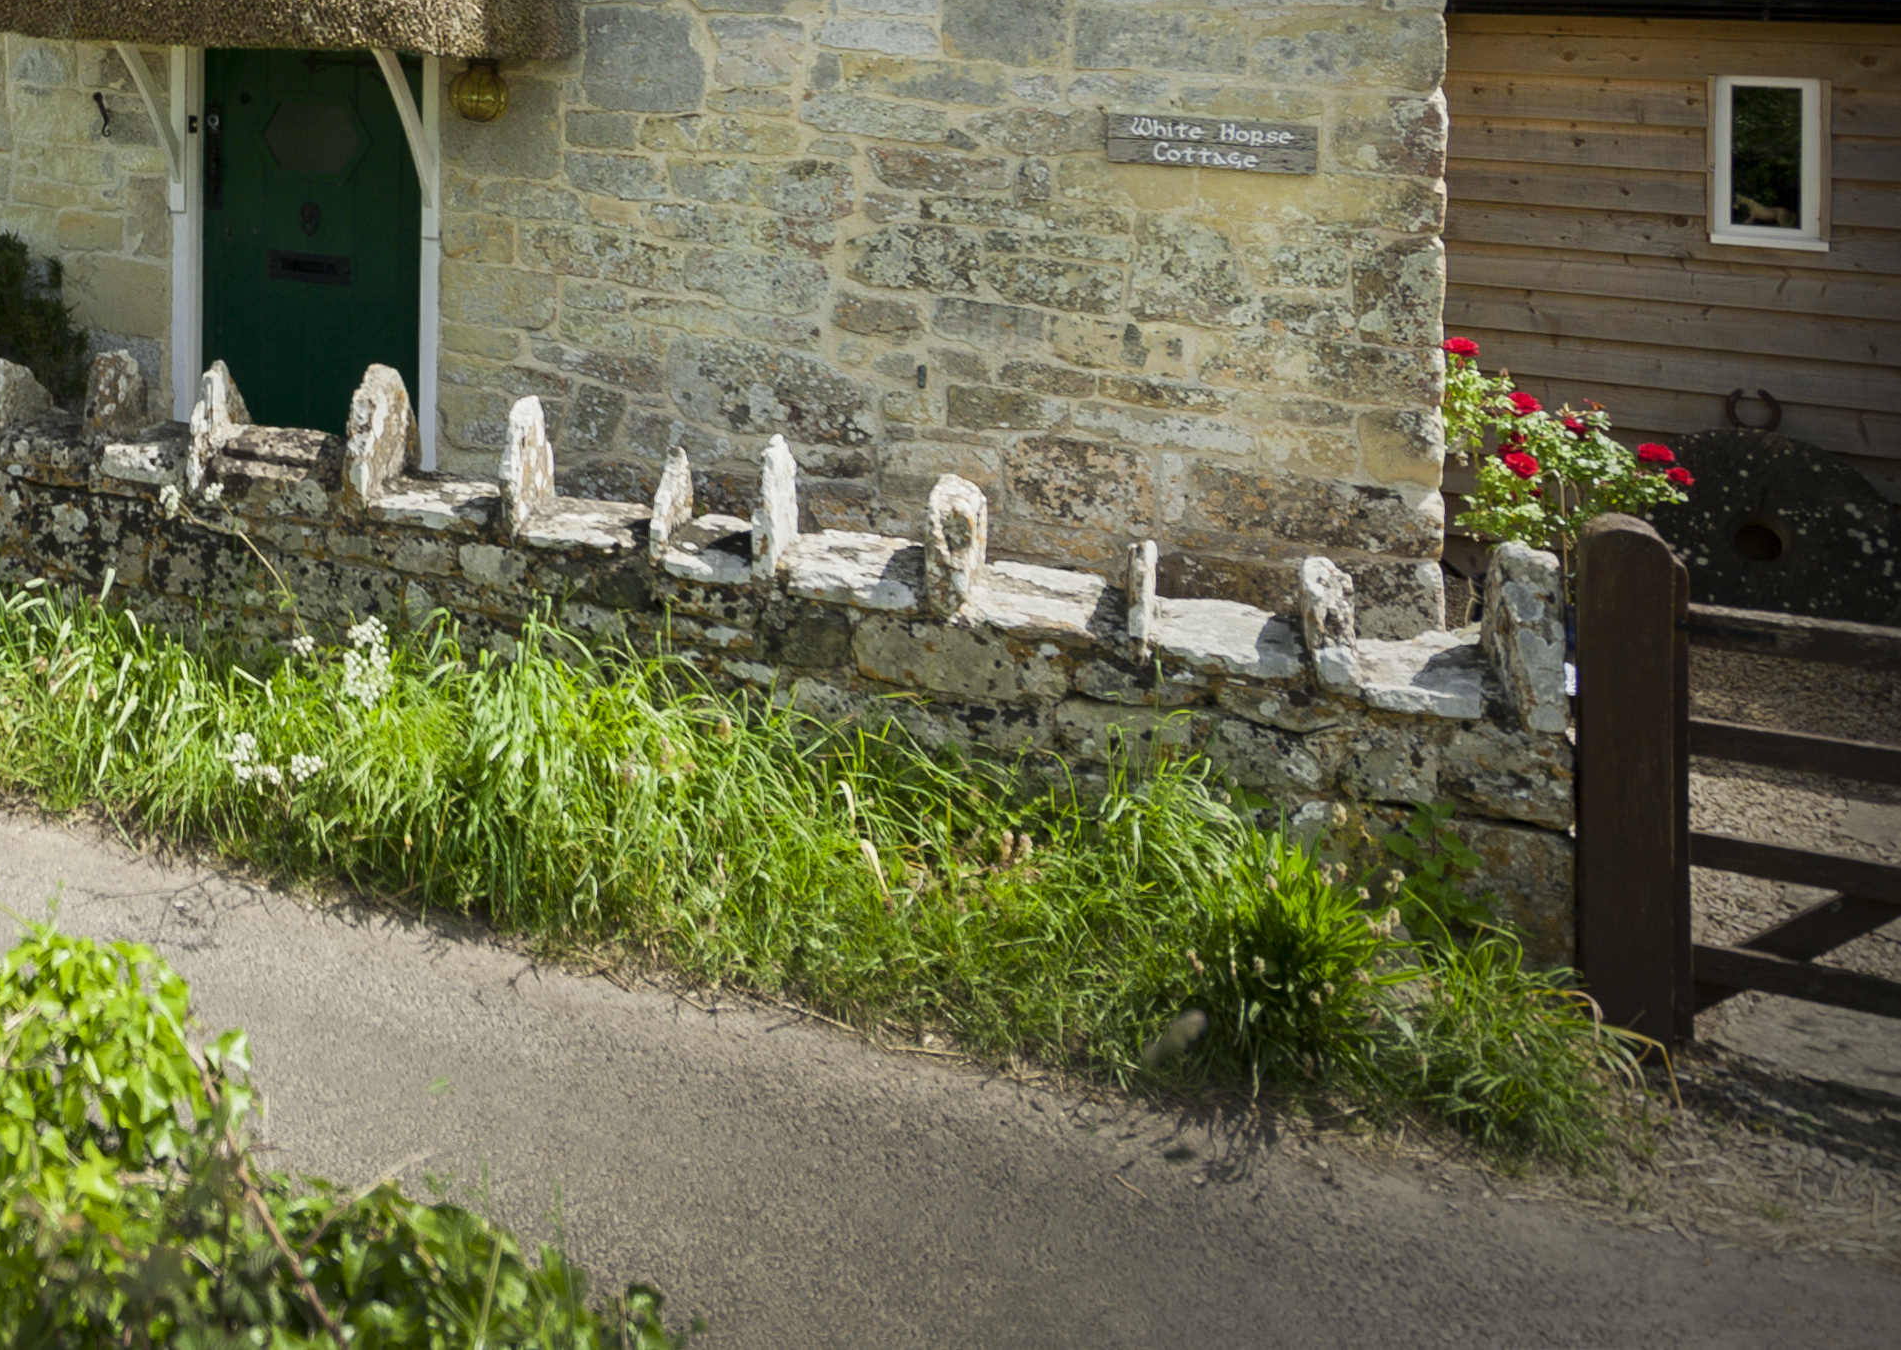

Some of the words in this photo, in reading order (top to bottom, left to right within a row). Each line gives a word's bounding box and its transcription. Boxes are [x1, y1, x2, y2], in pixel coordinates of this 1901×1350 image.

[1130, 117, 1205, 139] White
[1220, 124, 1295, 146] Horse
[1153, 142, 1259, 169] Cottage
